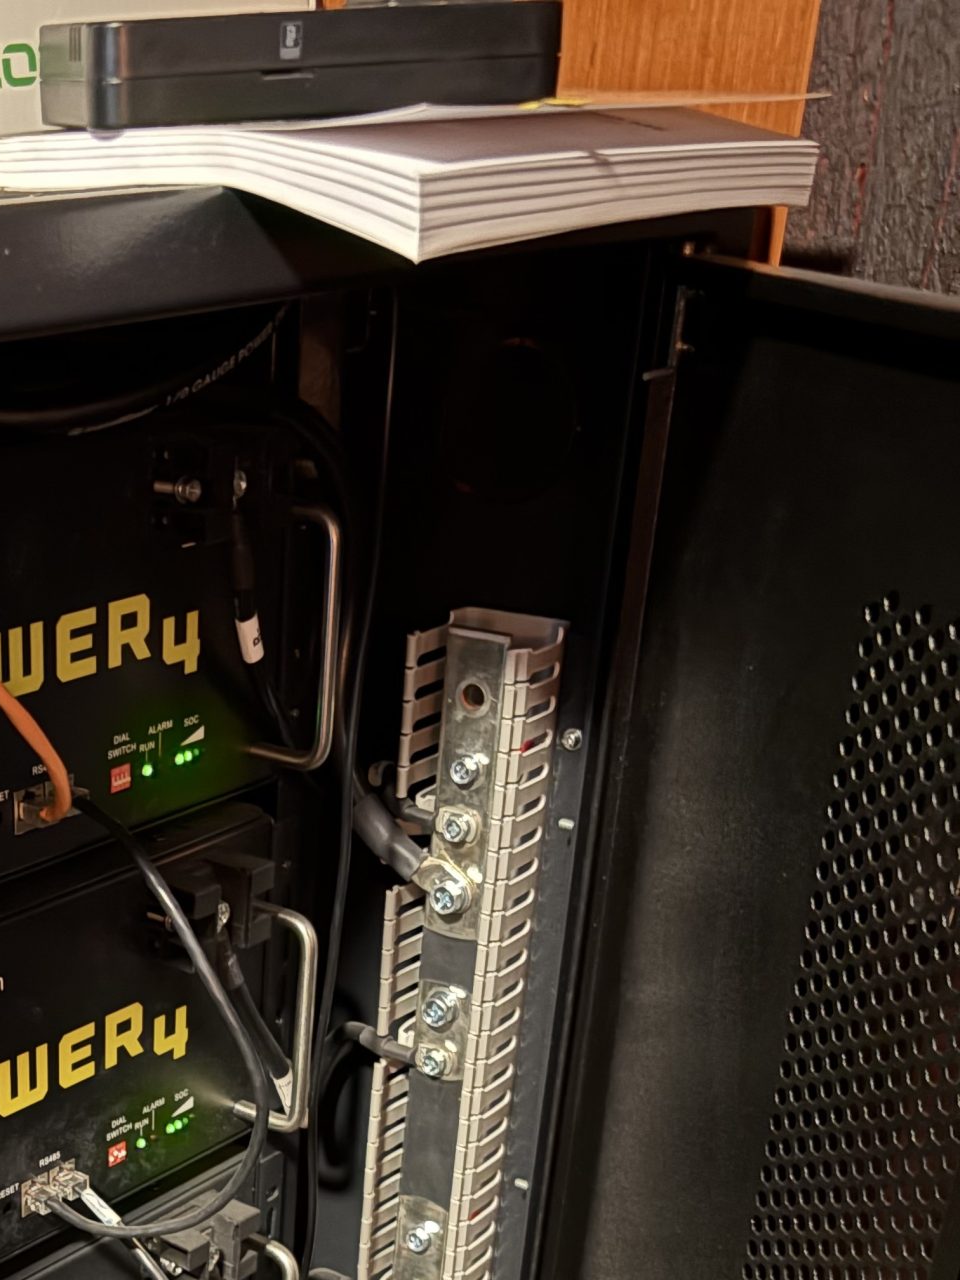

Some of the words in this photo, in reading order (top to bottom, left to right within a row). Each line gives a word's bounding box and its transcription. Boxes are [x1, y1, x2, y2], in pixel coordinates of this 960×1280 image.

[192, 355, 237, 393] GAUGE
[148, 719, 173, 735] ALARM
[183, 714, 200, 728] SOC
[113, 732, 130, 746] DIAL
[107, 742, 137, 761] SWITCH
[139, 740, 156, 754] RUN
[174, 1088, 189, 1102] SOC
[142, 1097, 166, 1114] ALARM
[106, 1122, 133, 1142] SWITCH
[134, 1117, 149, 1130] RUN
[111, 1115, 127, 1128] DIAL
[39, 1151, 61, 1168] RS485
